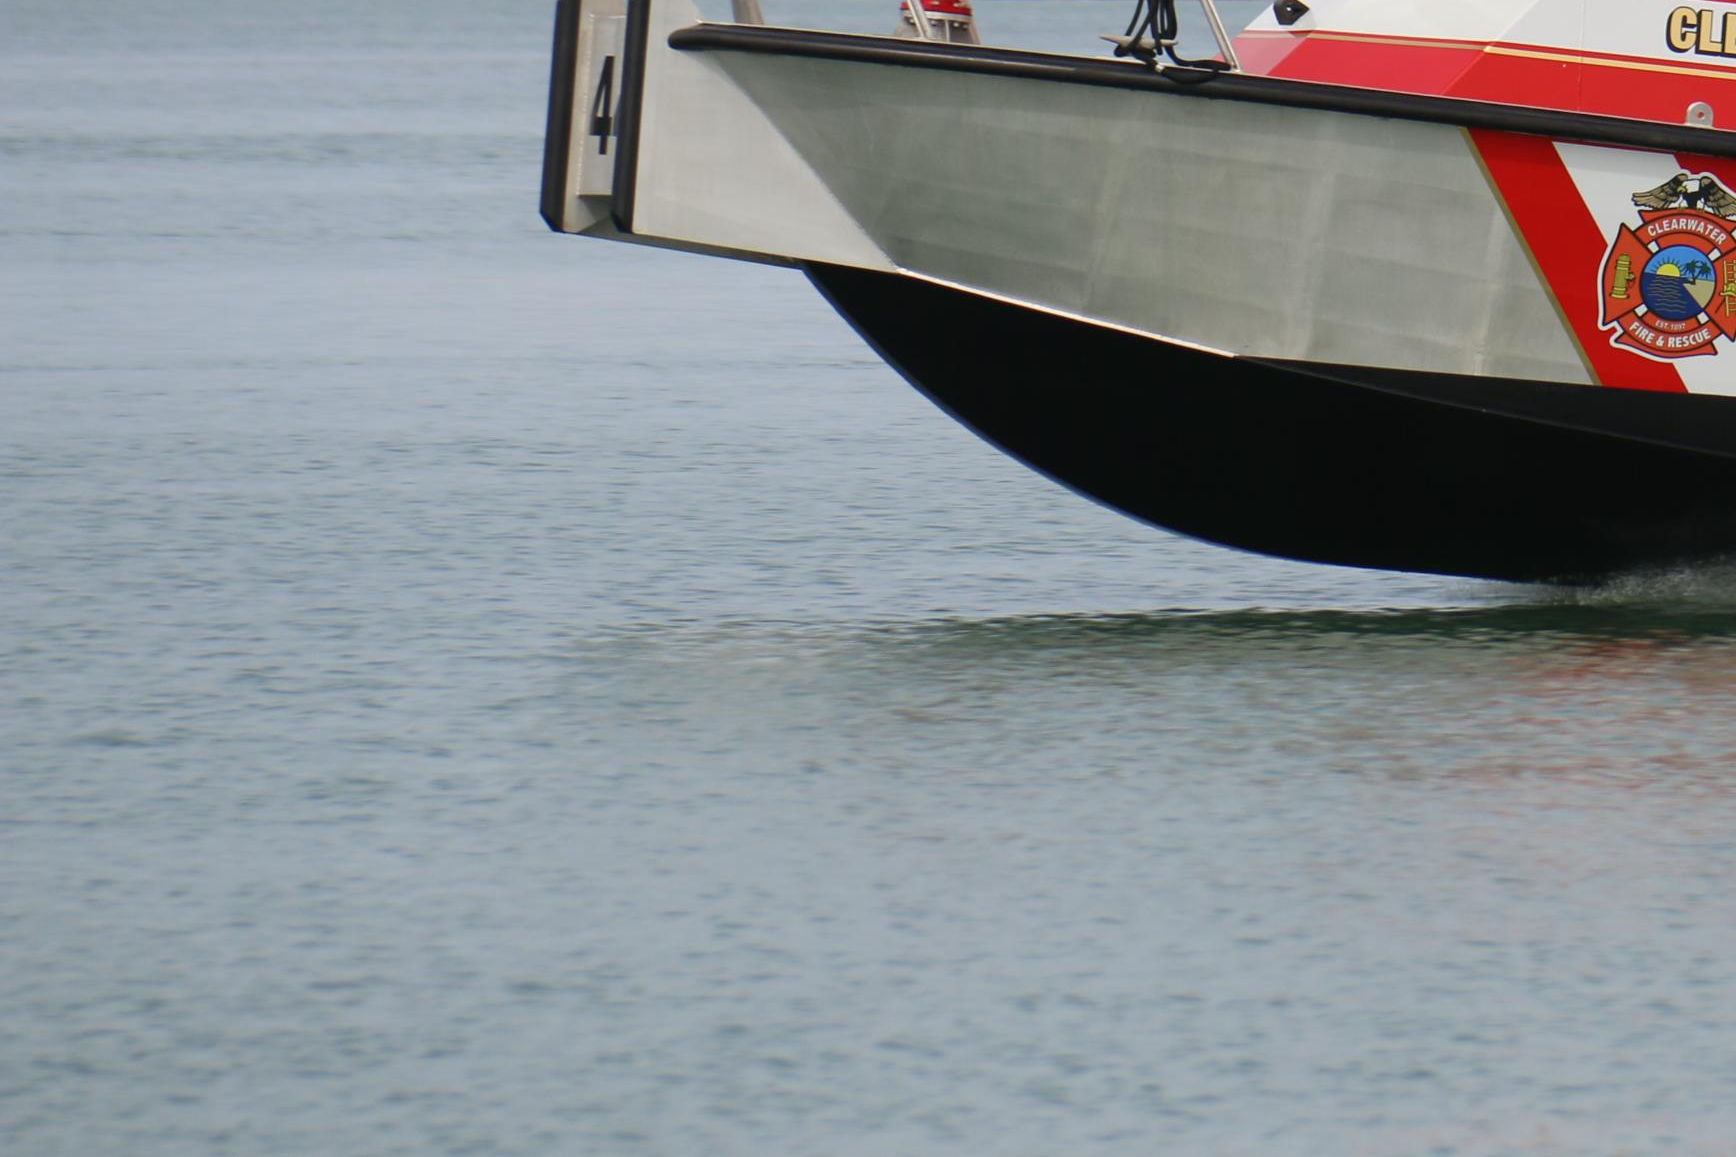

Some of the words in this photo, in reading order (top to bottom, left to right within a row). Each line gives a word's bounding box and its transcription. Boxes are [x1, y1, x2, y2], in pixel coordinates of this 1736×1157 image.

[589, 55, 620, 155] 4
[1647, 218, 1727, 245] CLEARWATER
[1629, 321, 1655, 344] FIRE
[1656, 335, 1665, 347] &
[1667, 328, 1712, 348] RESCUE
